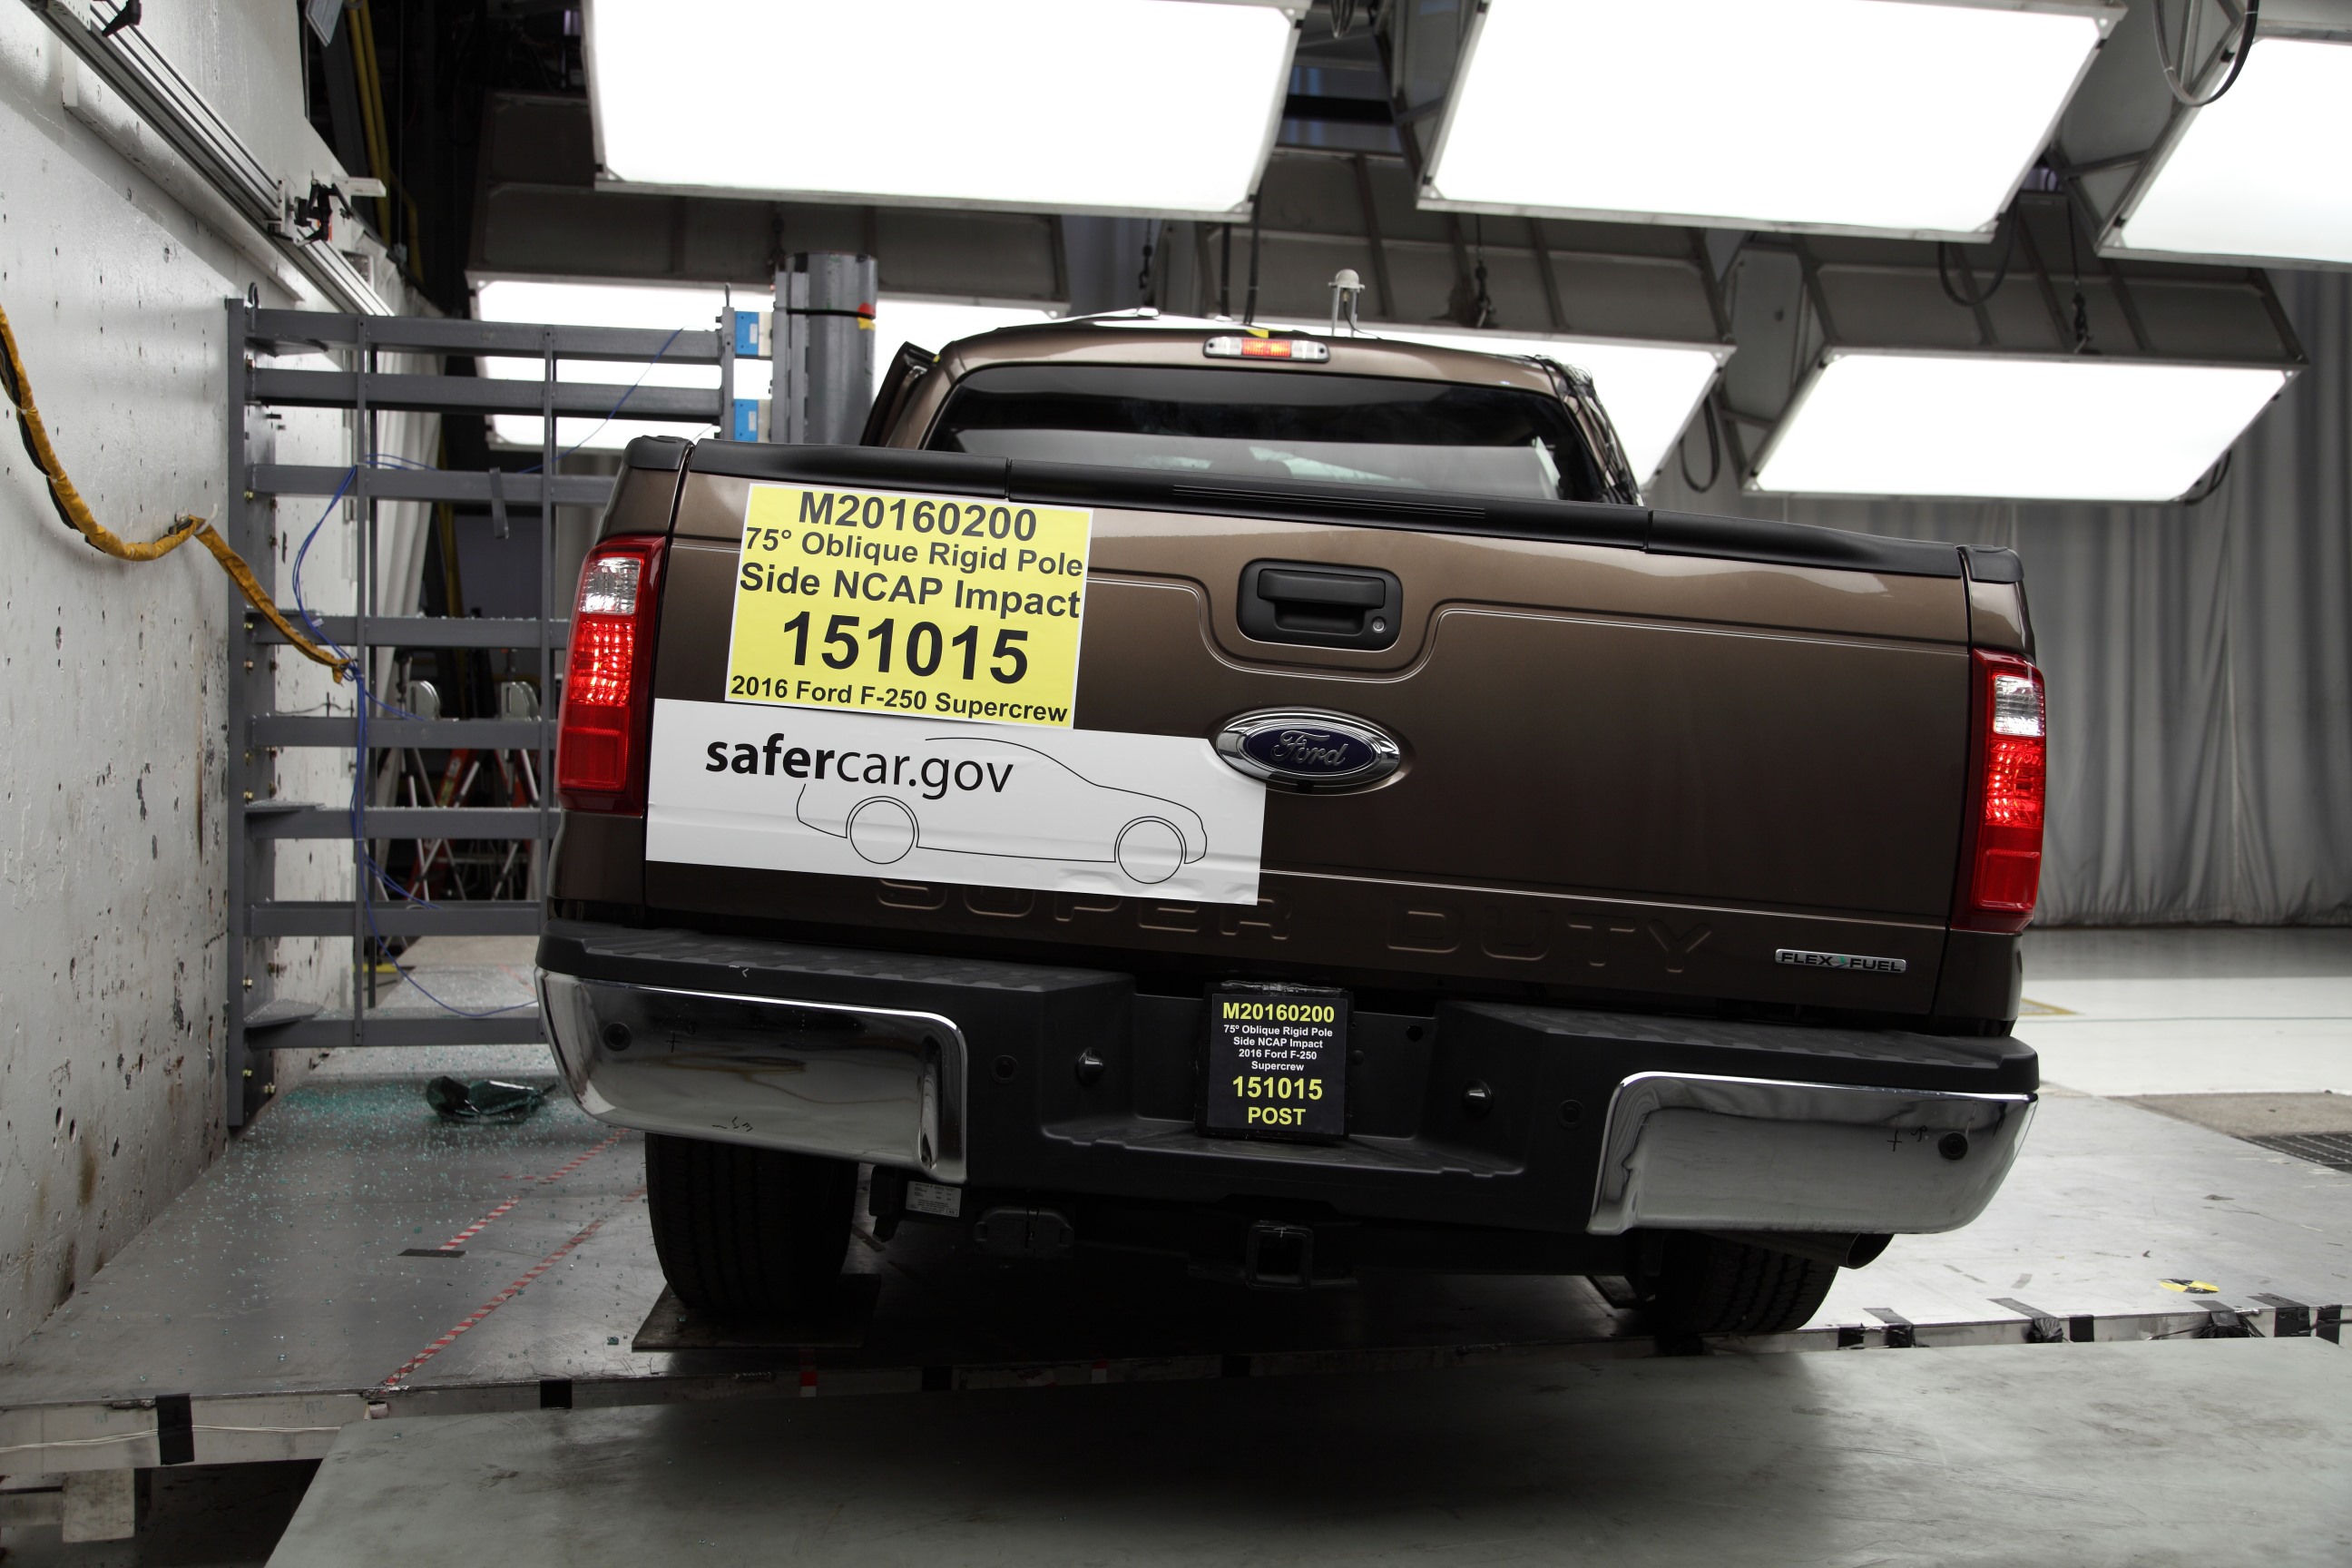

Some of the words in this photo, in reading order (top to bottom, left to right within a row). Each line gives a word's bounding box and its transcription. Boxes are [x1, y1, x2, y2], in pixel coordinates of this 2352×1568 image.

[799, 491, 1037, 542] M20160200
[746, 526, 792, 552] 75°
[802, 532, 918, 566] Oblique
[928, 542, 1007, 574] Rigid
[1017, 549, 1083, 577] Pole
[740, 562, 820, 596] Side
[834, 570, 944, 605] NCAP
[955, 580, 1081, 620] Impact
[783, 611, 1029, 685] 151015
[730, 675, 789, 699] 2016
[796, 681, 853, 704] Ford
[860, 686, 927, 710] F-250
[935, 692, 1068, 722] Supercrew
[1270, 730, 1349, 767] Ford
[705, 732, 1014, 800] safercar.gov
[1386, 899, 1712, 974] DUTY
[1780, 952, 1834, 966] FLEX
[1849, 957, 1902, 972] FUEL
[1222, 1002, 1334, 1023] M20160200
[1233, 1036, 1255, 1044] Side
[1258, 1037, 1287, 1046] NCAP
[1289, 1039, 1322, 1048] Impact
[1241, 1024, 1279, 1035] Oblique
[1282, 1026, 1308, 1036] Rigid
[1311, 1027, 1332, 1036] Pole
[1238, 1049, 1261, 1057] 2016
[1264, 1050, 1287, 1058] Ford
[1289, 1050, 1317, 1059] F-250
[1251, 1060, 1304, 1071] Supercrew
[1232, 1075, 1322, 1100] 151015
[1248, 1106, 1306, 1125] POST
